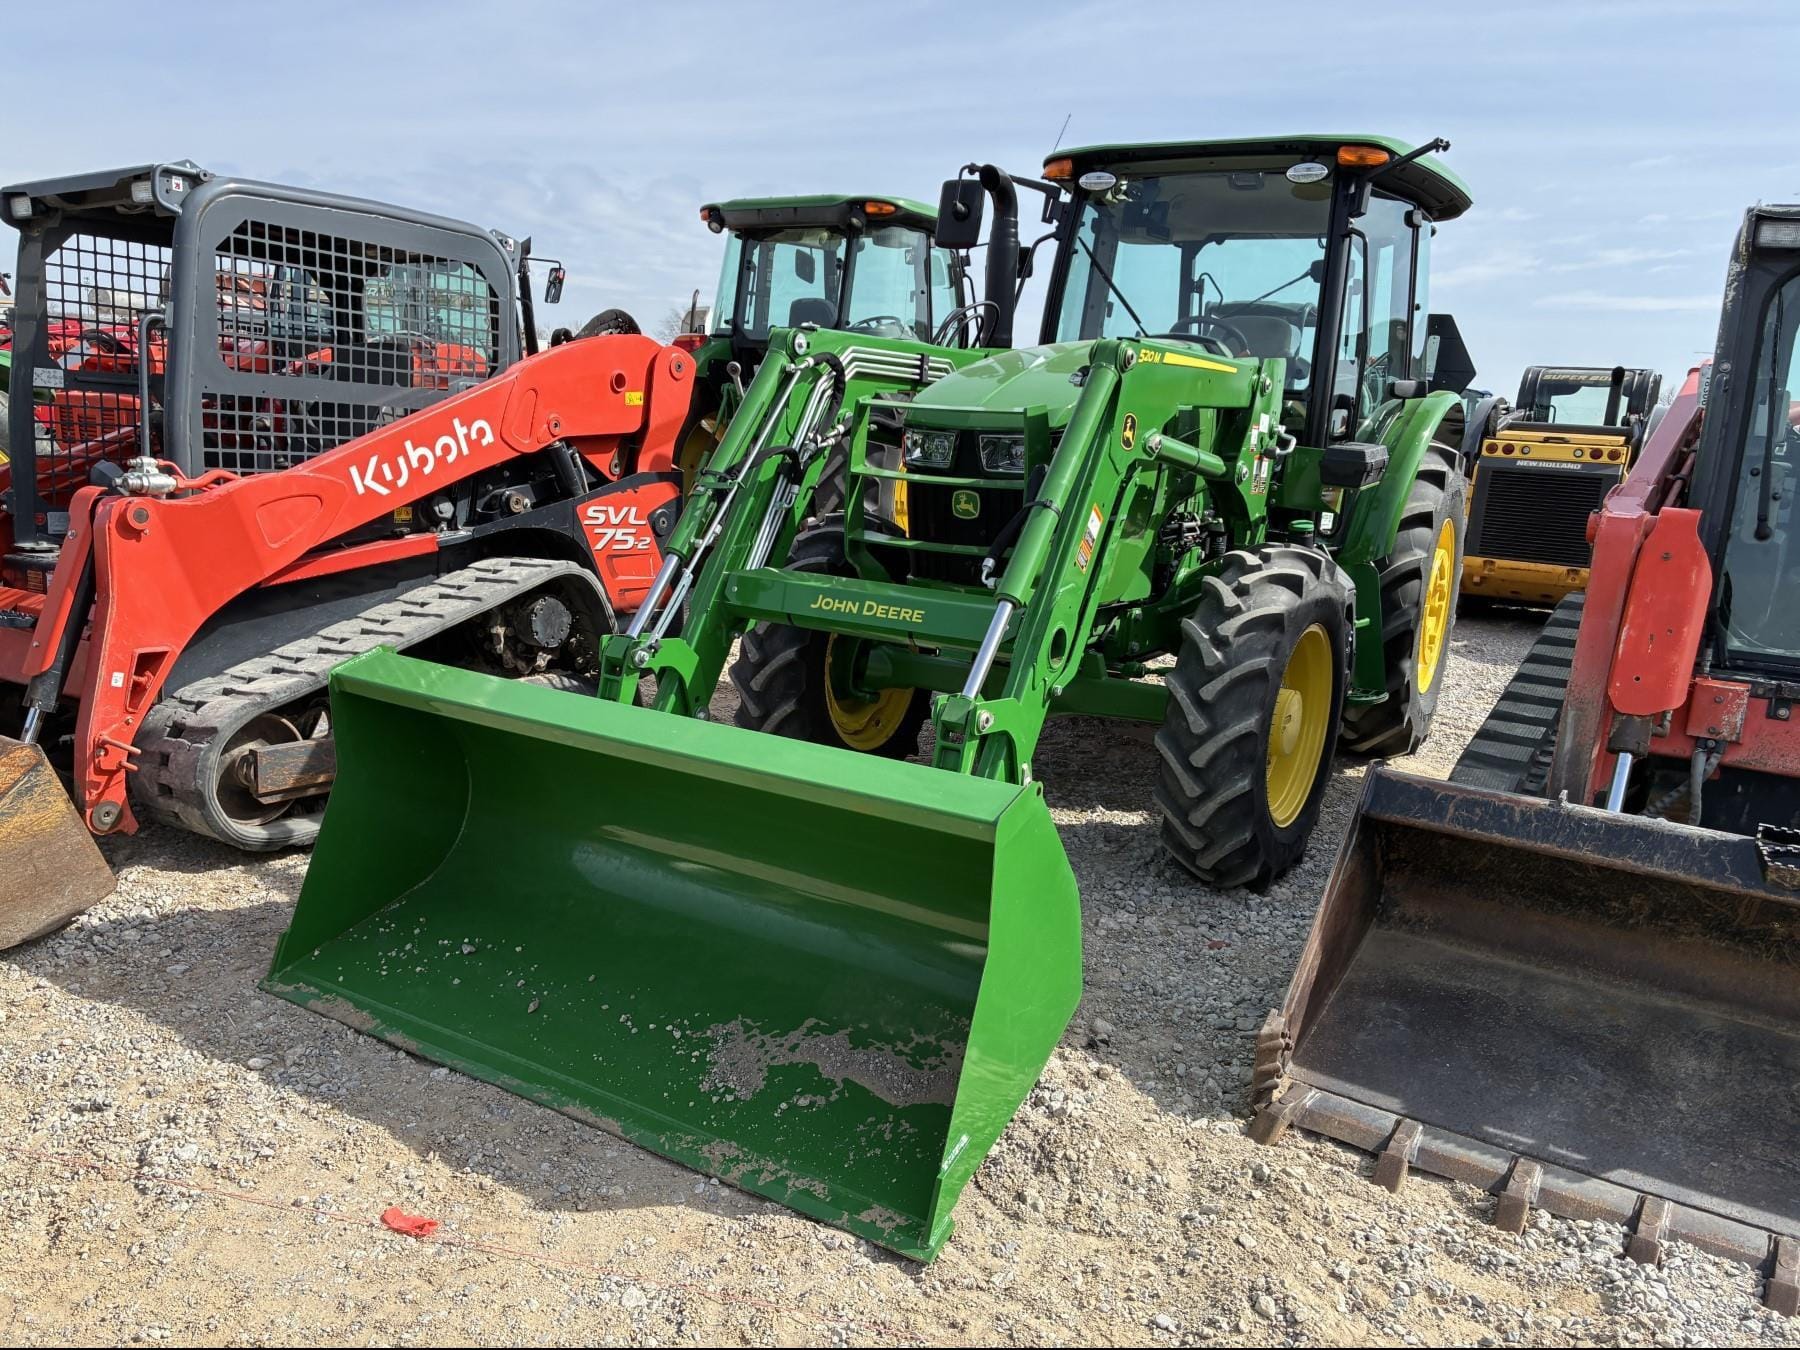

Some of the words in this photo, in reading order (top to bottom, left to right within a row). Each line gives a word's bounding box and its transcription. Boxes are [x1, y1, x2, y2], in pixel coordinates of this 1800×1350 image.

[349, 417, 494, 496] Kubota
[1539, 461, 1582, 470] HOLLAND
[583, 505, 647, 525] SVL
[593, 528, 651, 550] 75-2
[810, 594, 859, 614] JOHN
[862, 600, 925, 622] DEERE
